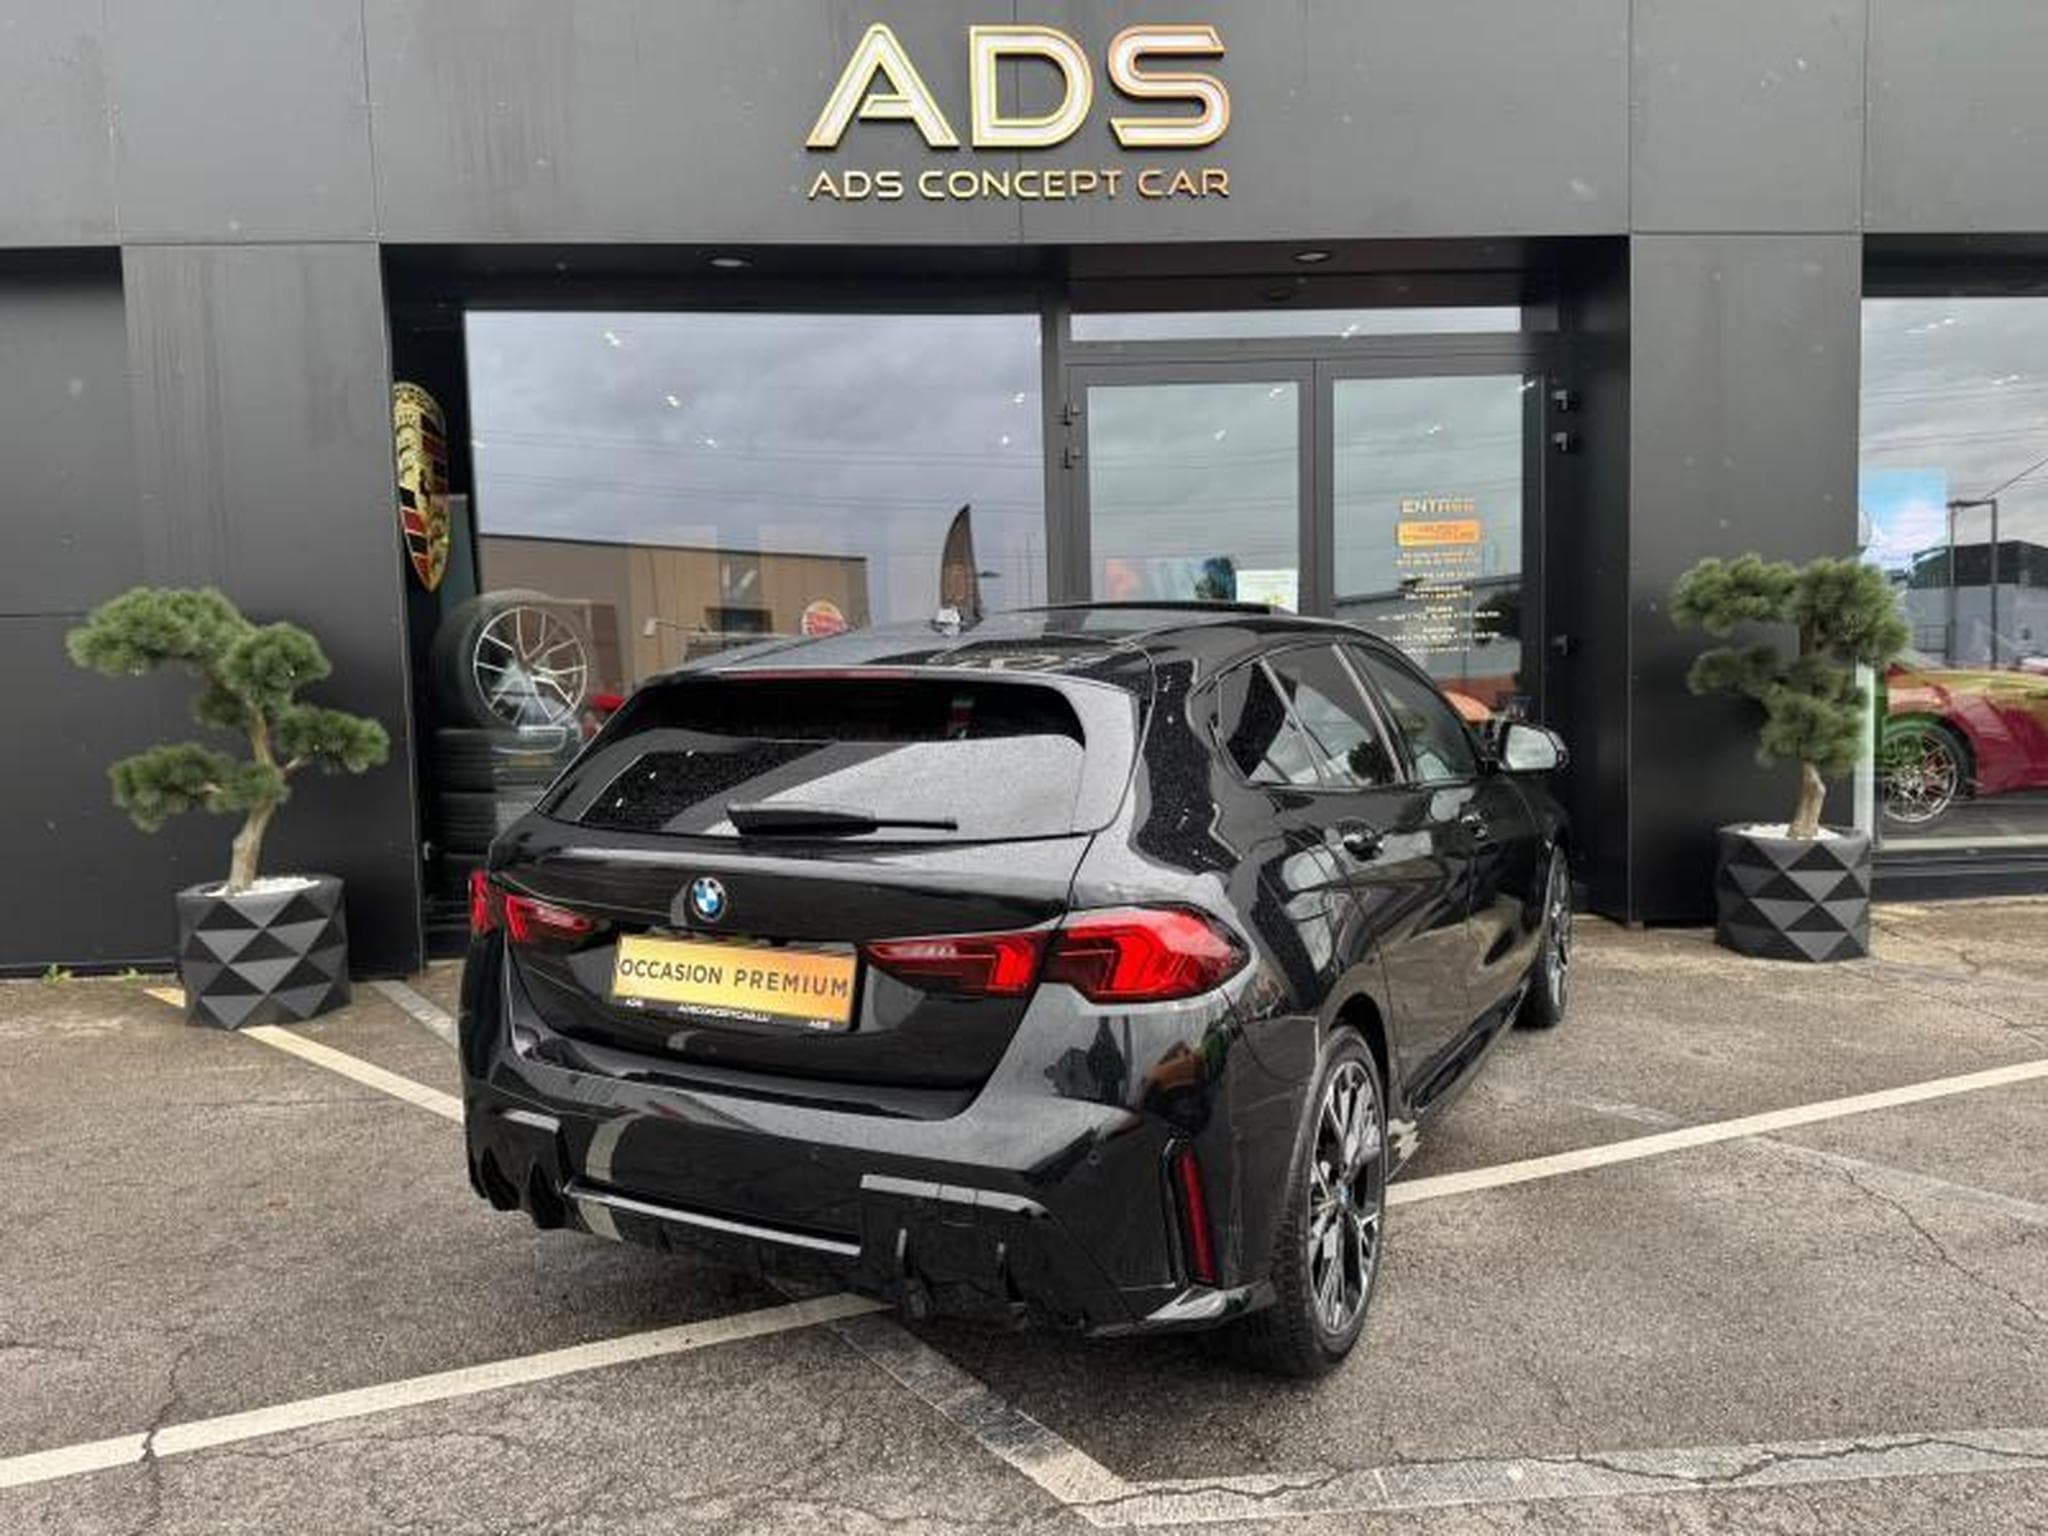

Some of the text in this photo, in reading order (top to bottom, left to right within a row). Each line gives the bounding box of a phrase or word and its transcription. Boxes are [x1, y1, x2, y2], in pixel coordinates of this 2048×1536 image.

[806, 23, 1230, 148] ADS
[809, 169, 1230, 199] ADS CONCEPT CAR
[1402, 498, 1474, 513] ENT
[620, 958, 848, 998] OCCASION PREMIUM
